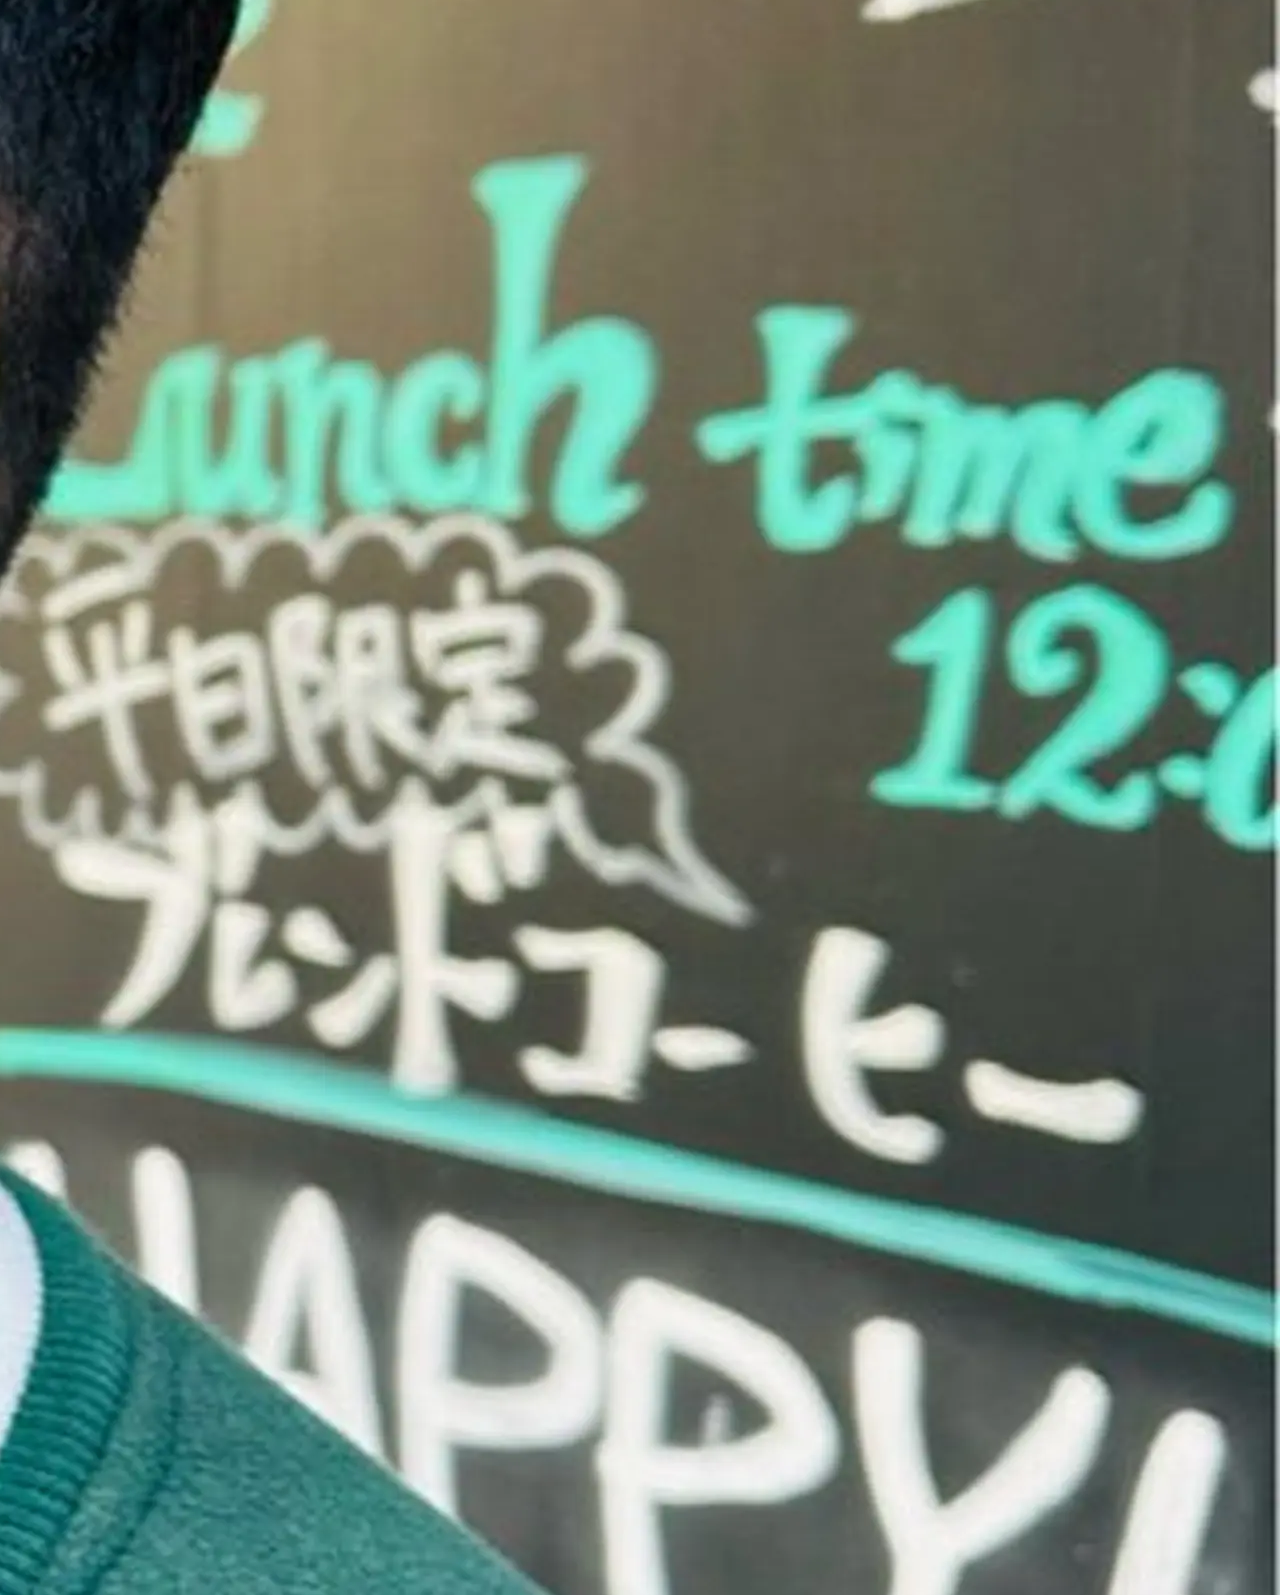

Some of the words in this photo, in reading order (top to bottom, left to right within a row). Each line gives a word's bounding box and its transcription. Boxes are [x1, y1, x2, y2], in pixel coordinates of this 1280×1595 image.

[694, 300, 1234, 563] time
[42, 568, 572, 804] 平日限定
